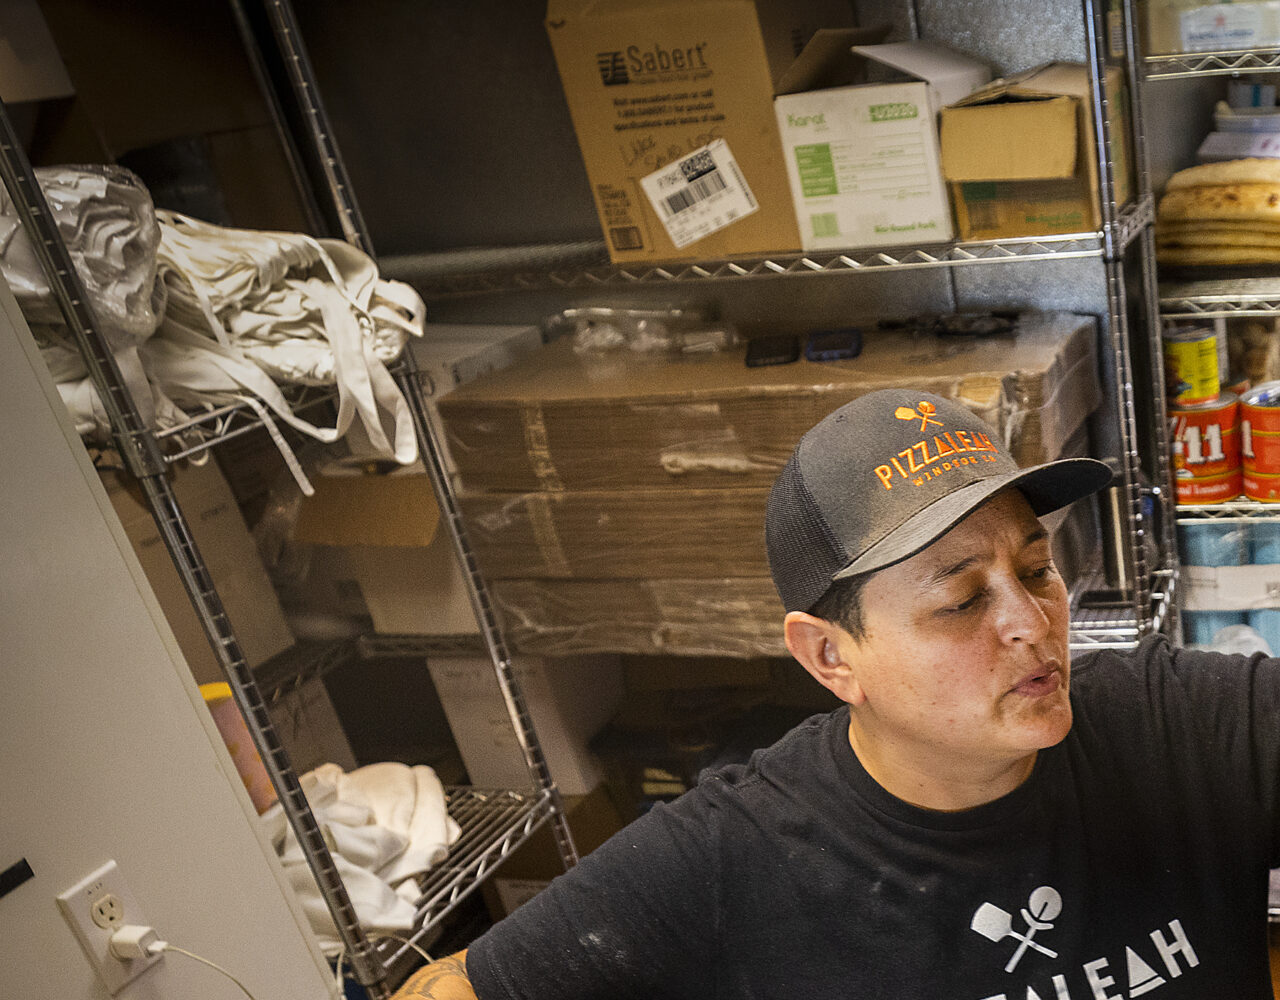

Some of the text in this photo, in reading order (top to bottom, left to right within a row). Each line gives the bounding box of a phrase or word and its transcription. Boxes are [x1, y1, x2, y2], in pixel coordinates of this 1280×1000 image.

[626, 43, 708, 74] Sabert
[873, 430, 999, 490] PIZZALEAH
[911, 456, 979, 487] WINDSOR
